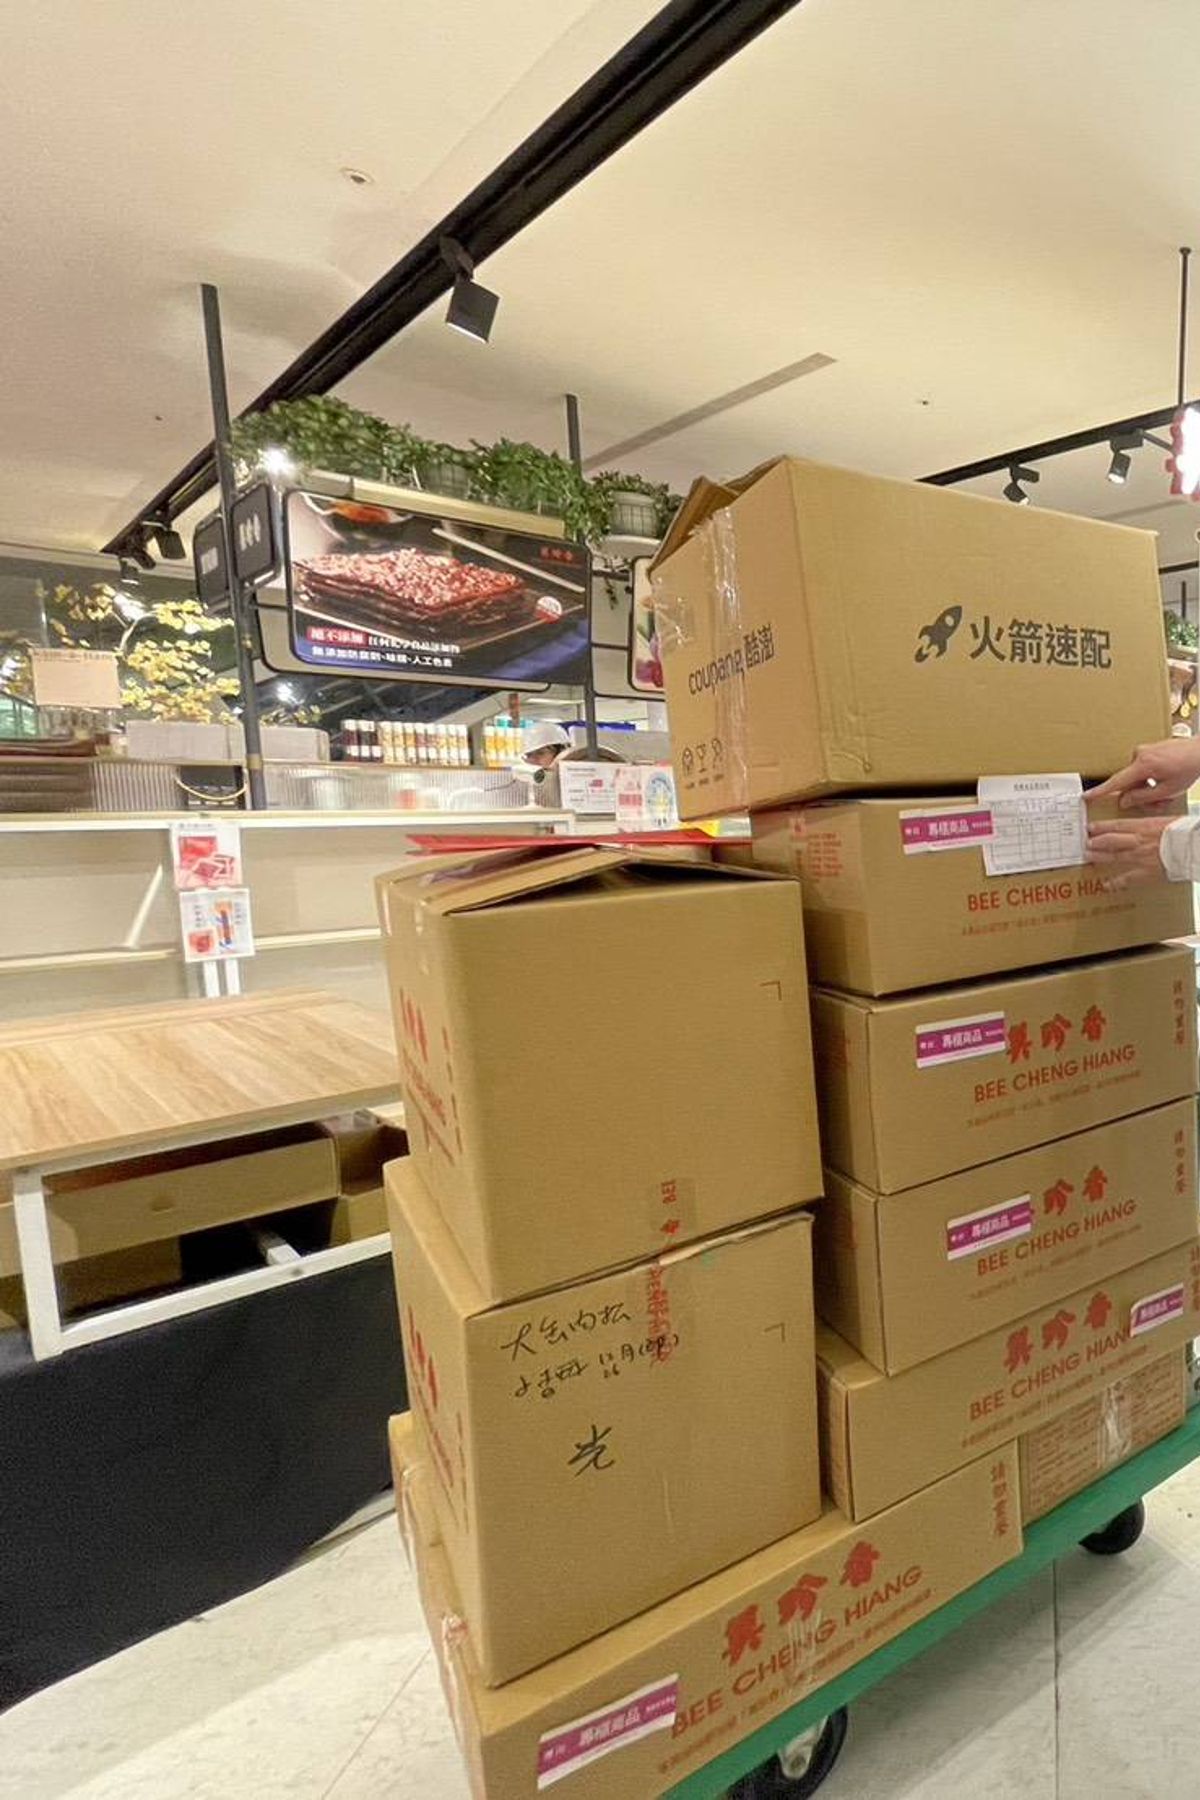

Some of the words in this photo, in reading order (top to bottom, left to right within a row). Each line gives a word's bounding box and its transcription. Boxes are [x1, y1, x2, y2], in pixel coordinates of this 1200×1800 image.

[688, 649, 745, 696] coupang
[743, 623, 775, 669] 酷澎
[969, 615, 1112, 669] 火箭速配
[967, 890, 1001, 912] BEE
[1006, 882, 1073, 907] CHENG
[1077, 876, 1128, 898] HIA
[1006, 1004, 1107, 1064] 美珍香
[973, 1078, 1008, 1103] BEE
[1012, 1060, 1079, 1092] CHENG
[1083, 1043, 1136, 1072] HIANG
[1030, 1165, 1108, 1216] 珍香
[976, 1252, 1010, 1277] BEE
[1014, 1221, 1081, 1261] CHENG
[1083, 1198, 1138, 1232] HIANG
[1003, 1290, 1113, 1374] 美珍香
[969, 1388, 1005, 1421] BEE
[1010, 1352, 1081, 1399] CHENG
[1085, 1327, 1132, 1363] HIAN
[721, 1540, 881, 1666] 美珍香
[672, 1688, 723, 1738] BEE
[732, 1618, 838, 1696] CHENG
[844, 1565, 923, 1625] HIANG
